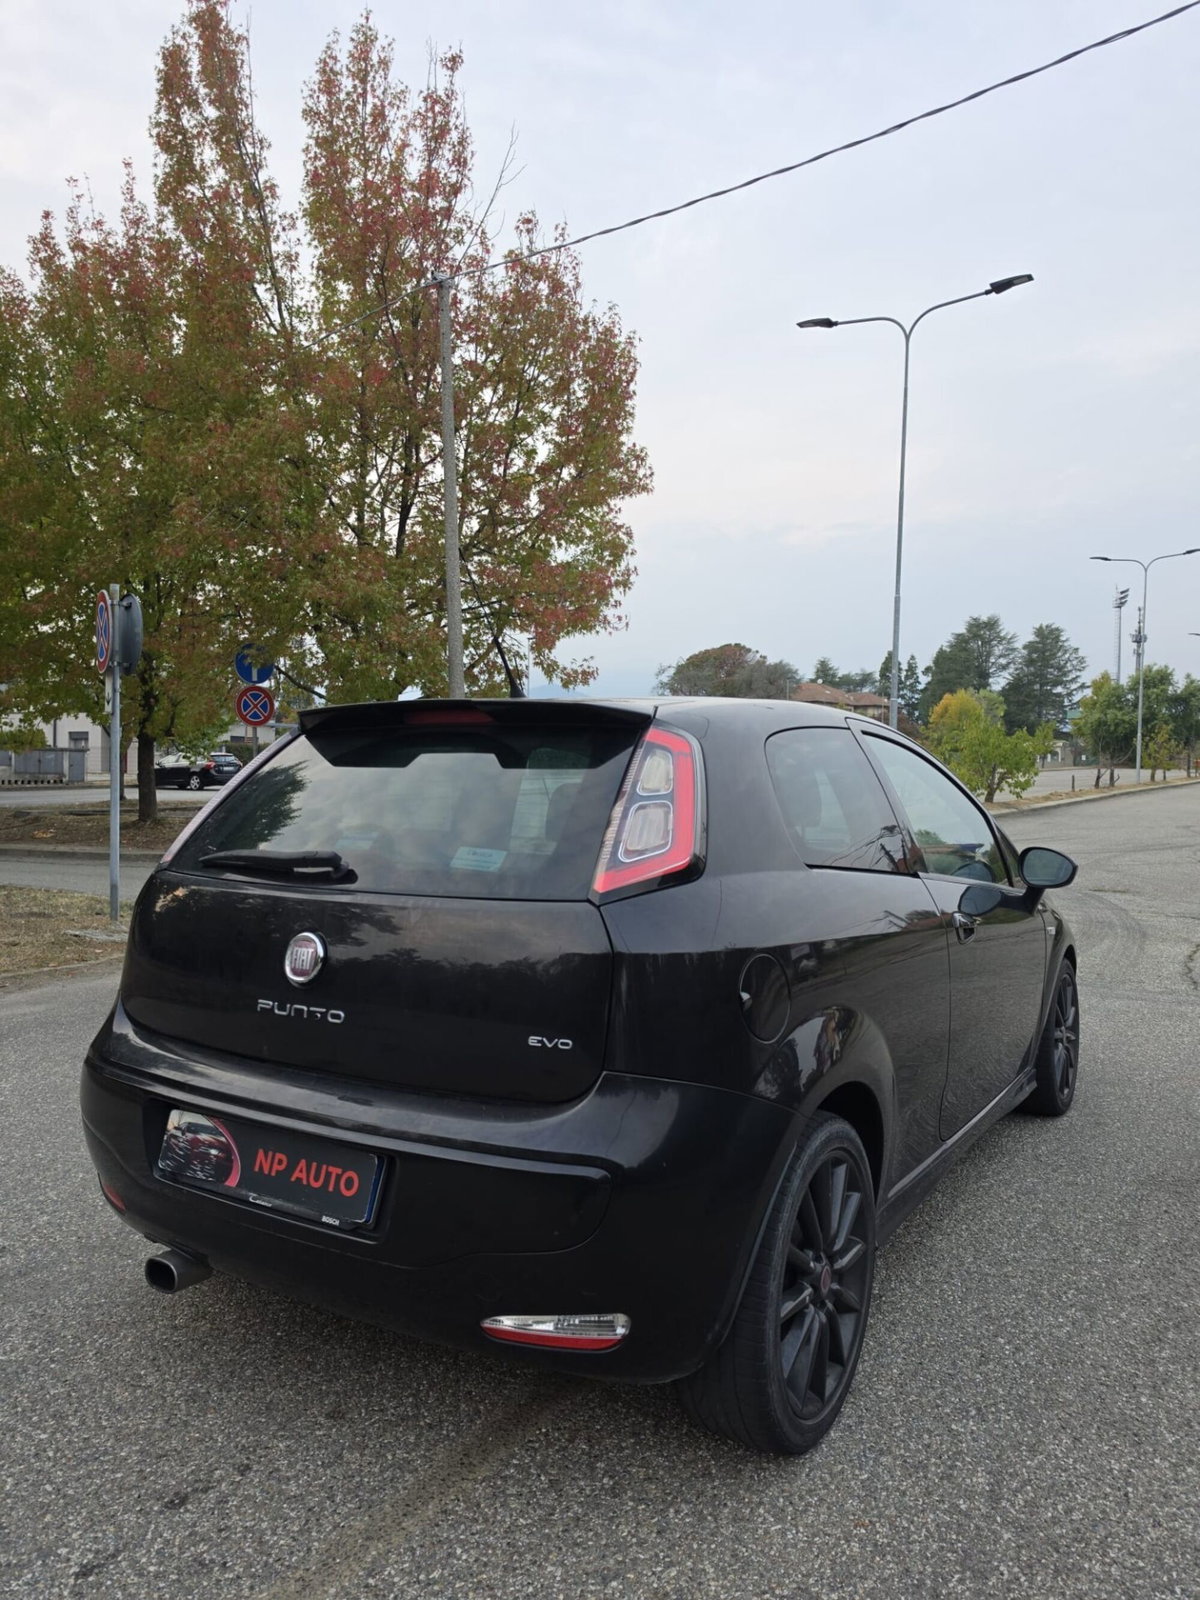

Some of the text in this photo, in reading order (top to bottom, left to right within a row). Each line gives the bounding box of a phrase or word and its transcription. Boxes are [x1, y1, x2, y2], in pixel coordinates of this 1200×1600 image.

[257, 999, 345, 1024] PUNTO
[528, 1035, 573, 1050] EVO
[254, 1148, 360, 1197] NP AUTO
[321, 1215, 340, 1226] BOSCH
